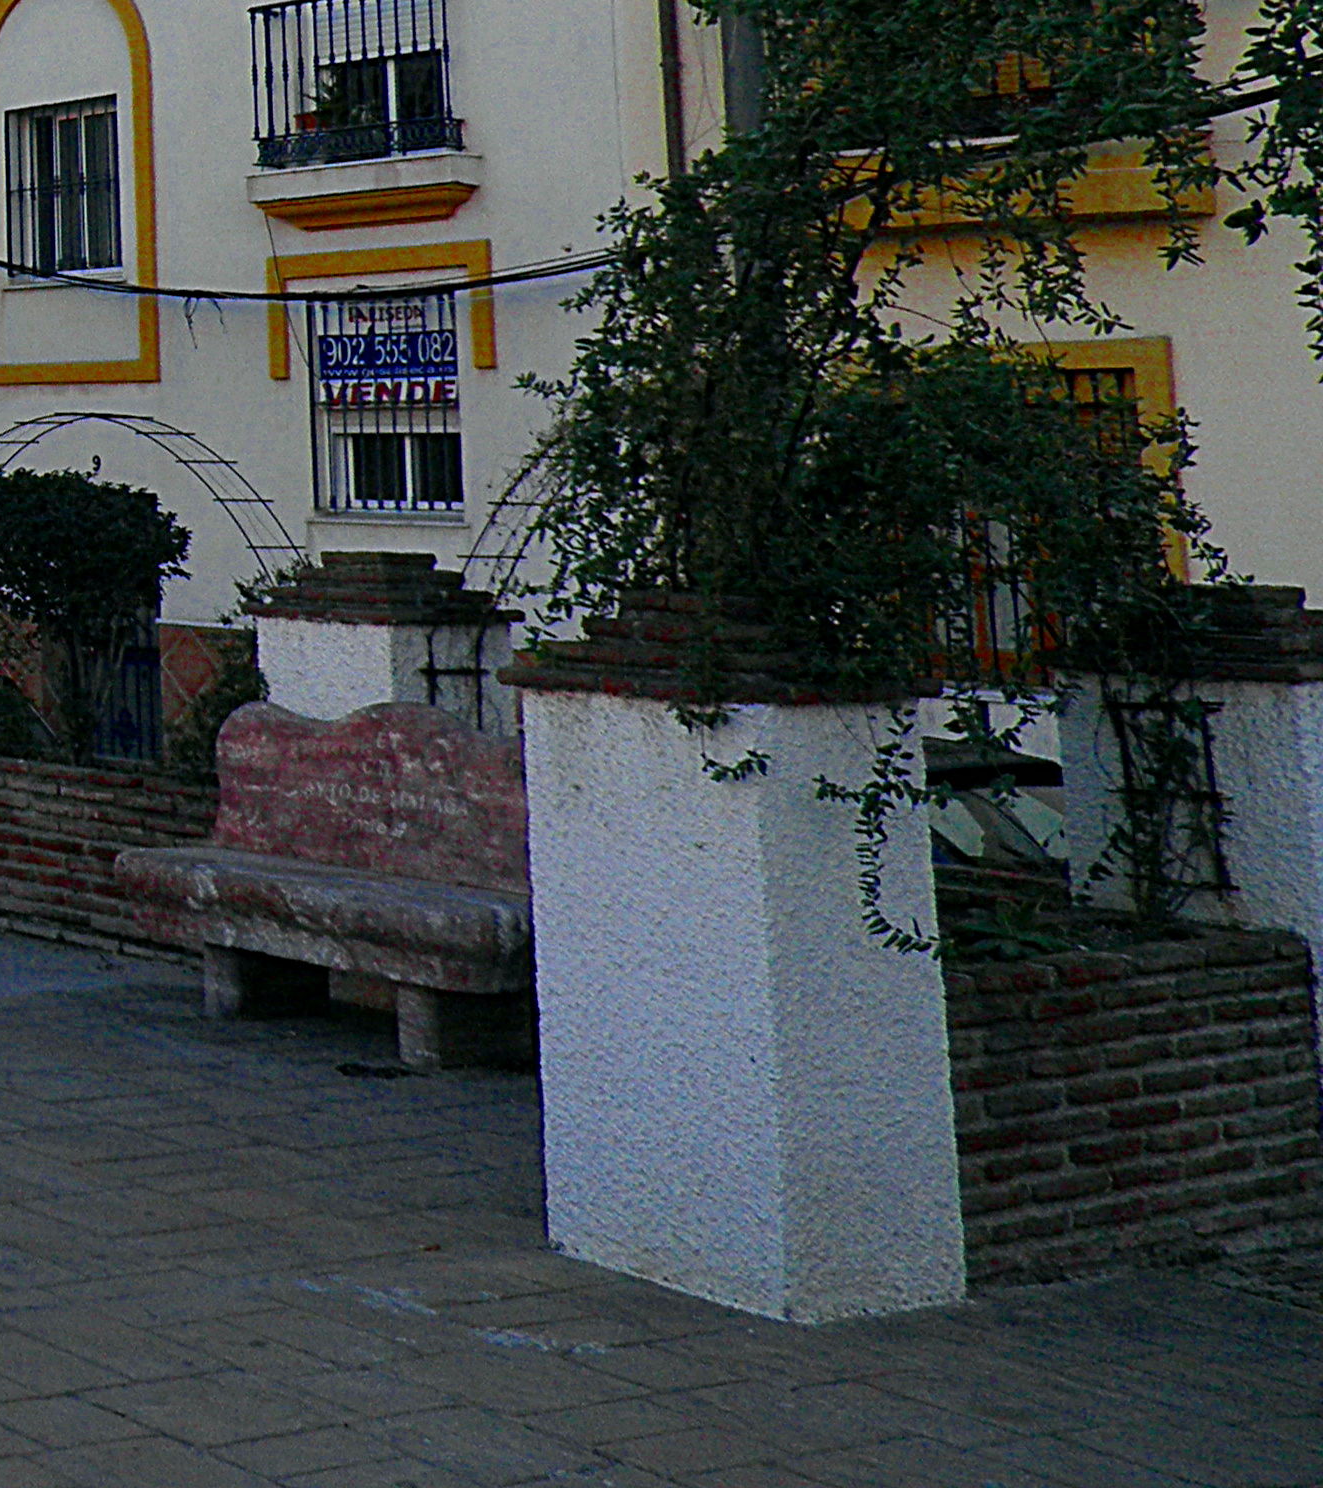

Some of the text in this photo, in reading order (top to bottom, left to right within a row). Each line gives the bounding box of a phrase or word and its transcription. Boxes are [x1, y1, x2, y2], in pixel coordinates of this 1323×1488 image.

[323, 332, 455, 366] 902 555 082
[320, 379, 456, 405] VENDE
[92, 454, 102, 472] 9
